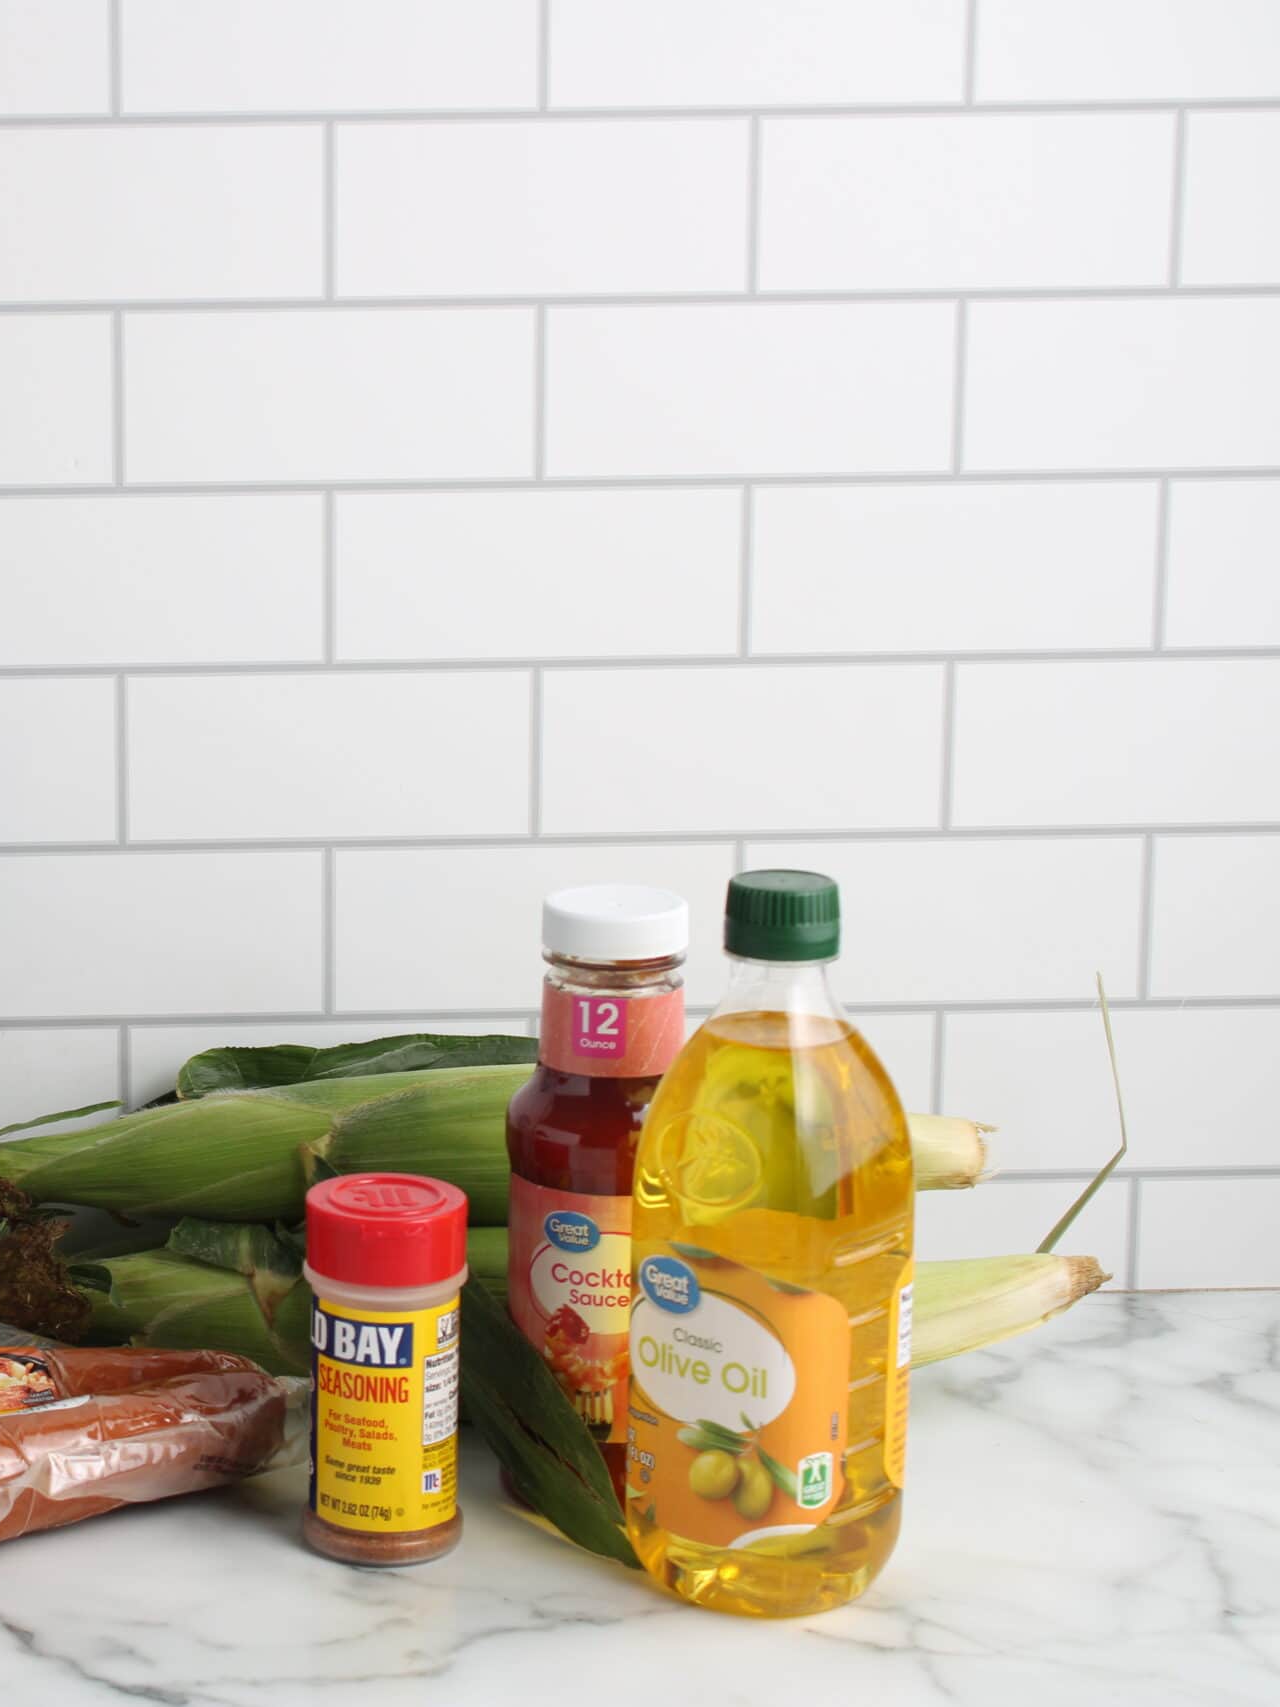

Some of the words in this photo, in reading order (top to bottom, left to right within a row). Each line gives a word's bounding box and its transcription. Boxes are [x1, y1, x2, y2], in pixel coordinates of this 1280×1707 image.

[579, 1001, 619, 1035] 12
[580, 1038, 617, 1050] Ounce
[550, 1218, 589, 1237] Great
[646, 1264, 689, 1294] Great
[569, 1289, 631, 1307] Sauce
[655, 1284, 689, 1306] Value
[334, 1319, 404, 1364] BAY
[672, 1327, 723, 1353] Classic
[639, 1335, 711, 1385] Olive
[722, 1362, 767, 1399] Oil
[320, 1363, 409, 1404] SEASONING
[328, 1409, 342, 1421] For
[344, 1413, 388, 1429] Seafood,
[342, 1438, 372, 1451] Meats
[335, 1471, 357, 1482] since
[347, 1463, 370, 1474] great
[372, 1465, 396, 1475] taste
